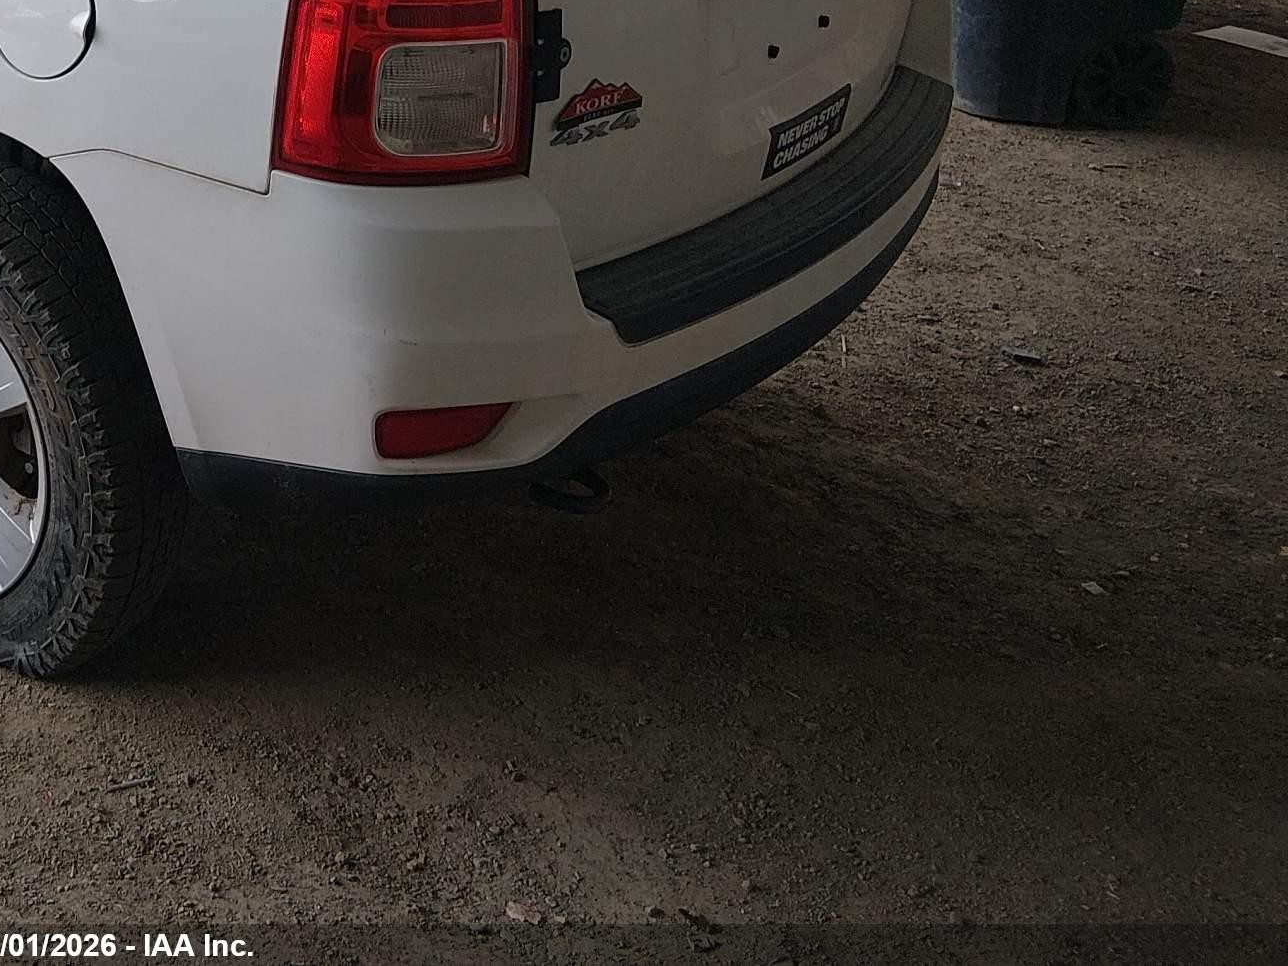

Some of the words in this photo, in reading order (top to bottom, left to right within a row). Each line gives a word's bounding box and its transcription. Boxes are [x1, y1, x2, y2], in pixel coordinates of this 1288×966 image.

[773, 125, 829, 169] CHASING
[777, 115, 819, 149] NEVER
[818, 97, 845, 126] STOP
